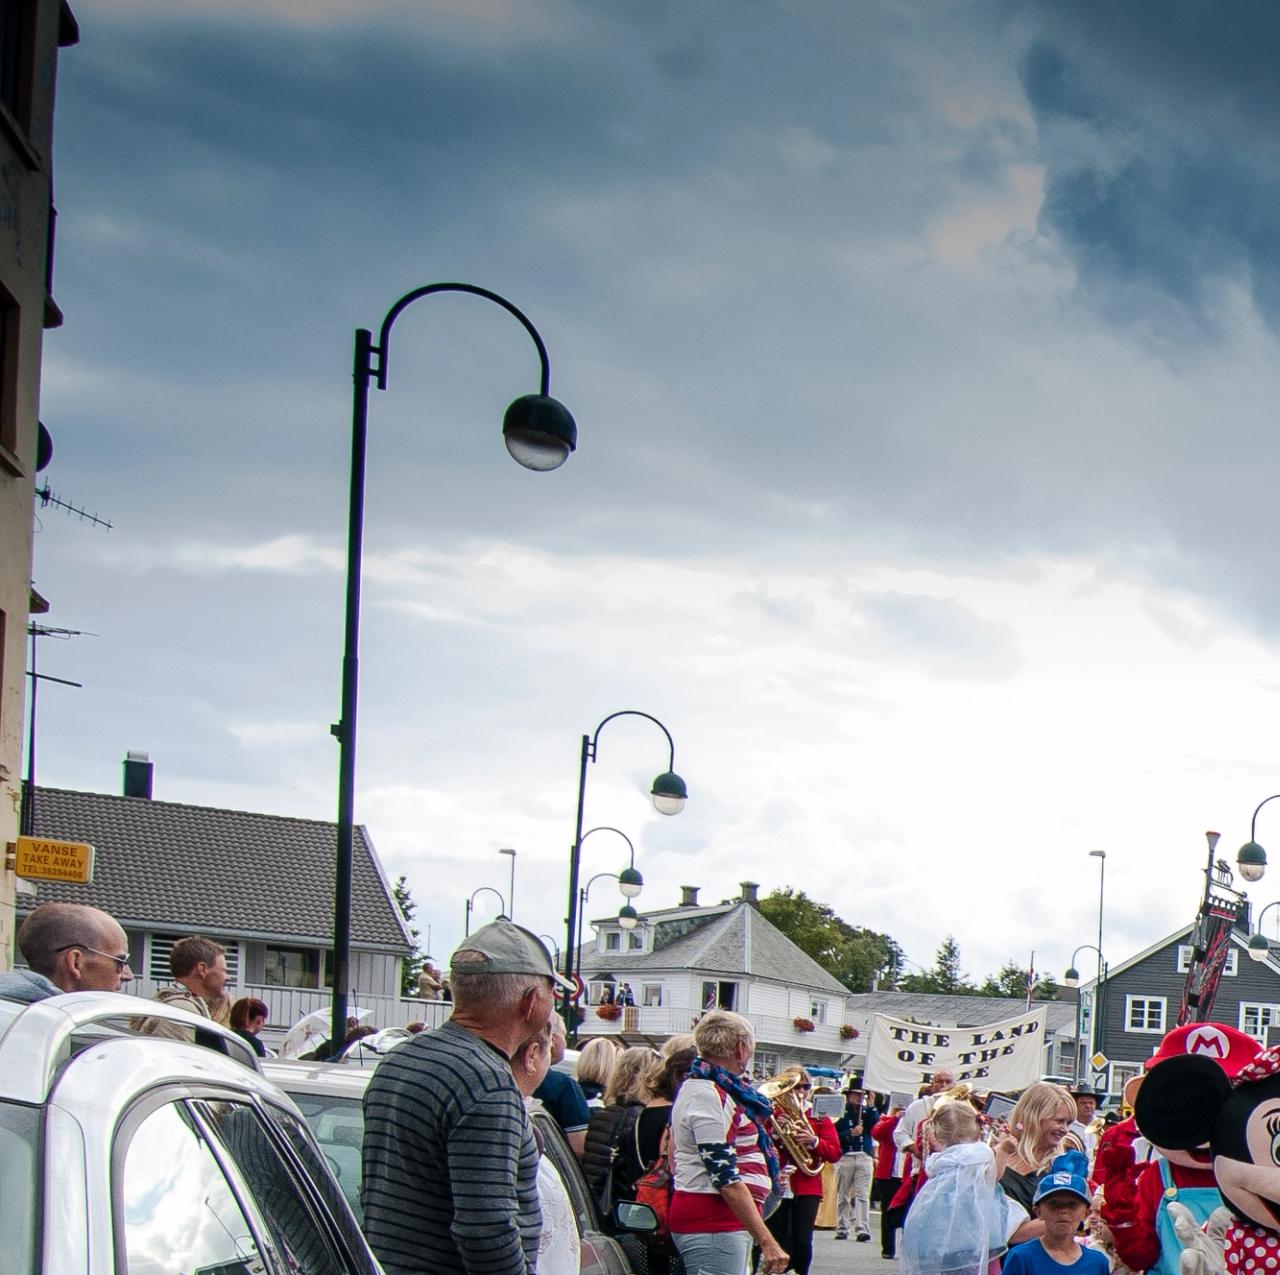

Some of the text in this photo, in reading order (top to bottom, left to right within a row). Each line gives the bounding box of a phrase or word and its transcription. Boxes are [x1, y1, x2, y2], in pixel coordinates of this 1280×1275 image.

[32, 842, 77, 857] VANSE
[23, 853, 84, 869] TAKE AWAY
[890, 1021, 1039, 1048] THE LAND
[898, 1044, 1015, 1066] OF THE
[1191, 1034, 1224, 1058] M
[921, 1066, 989, 1084] FEE
